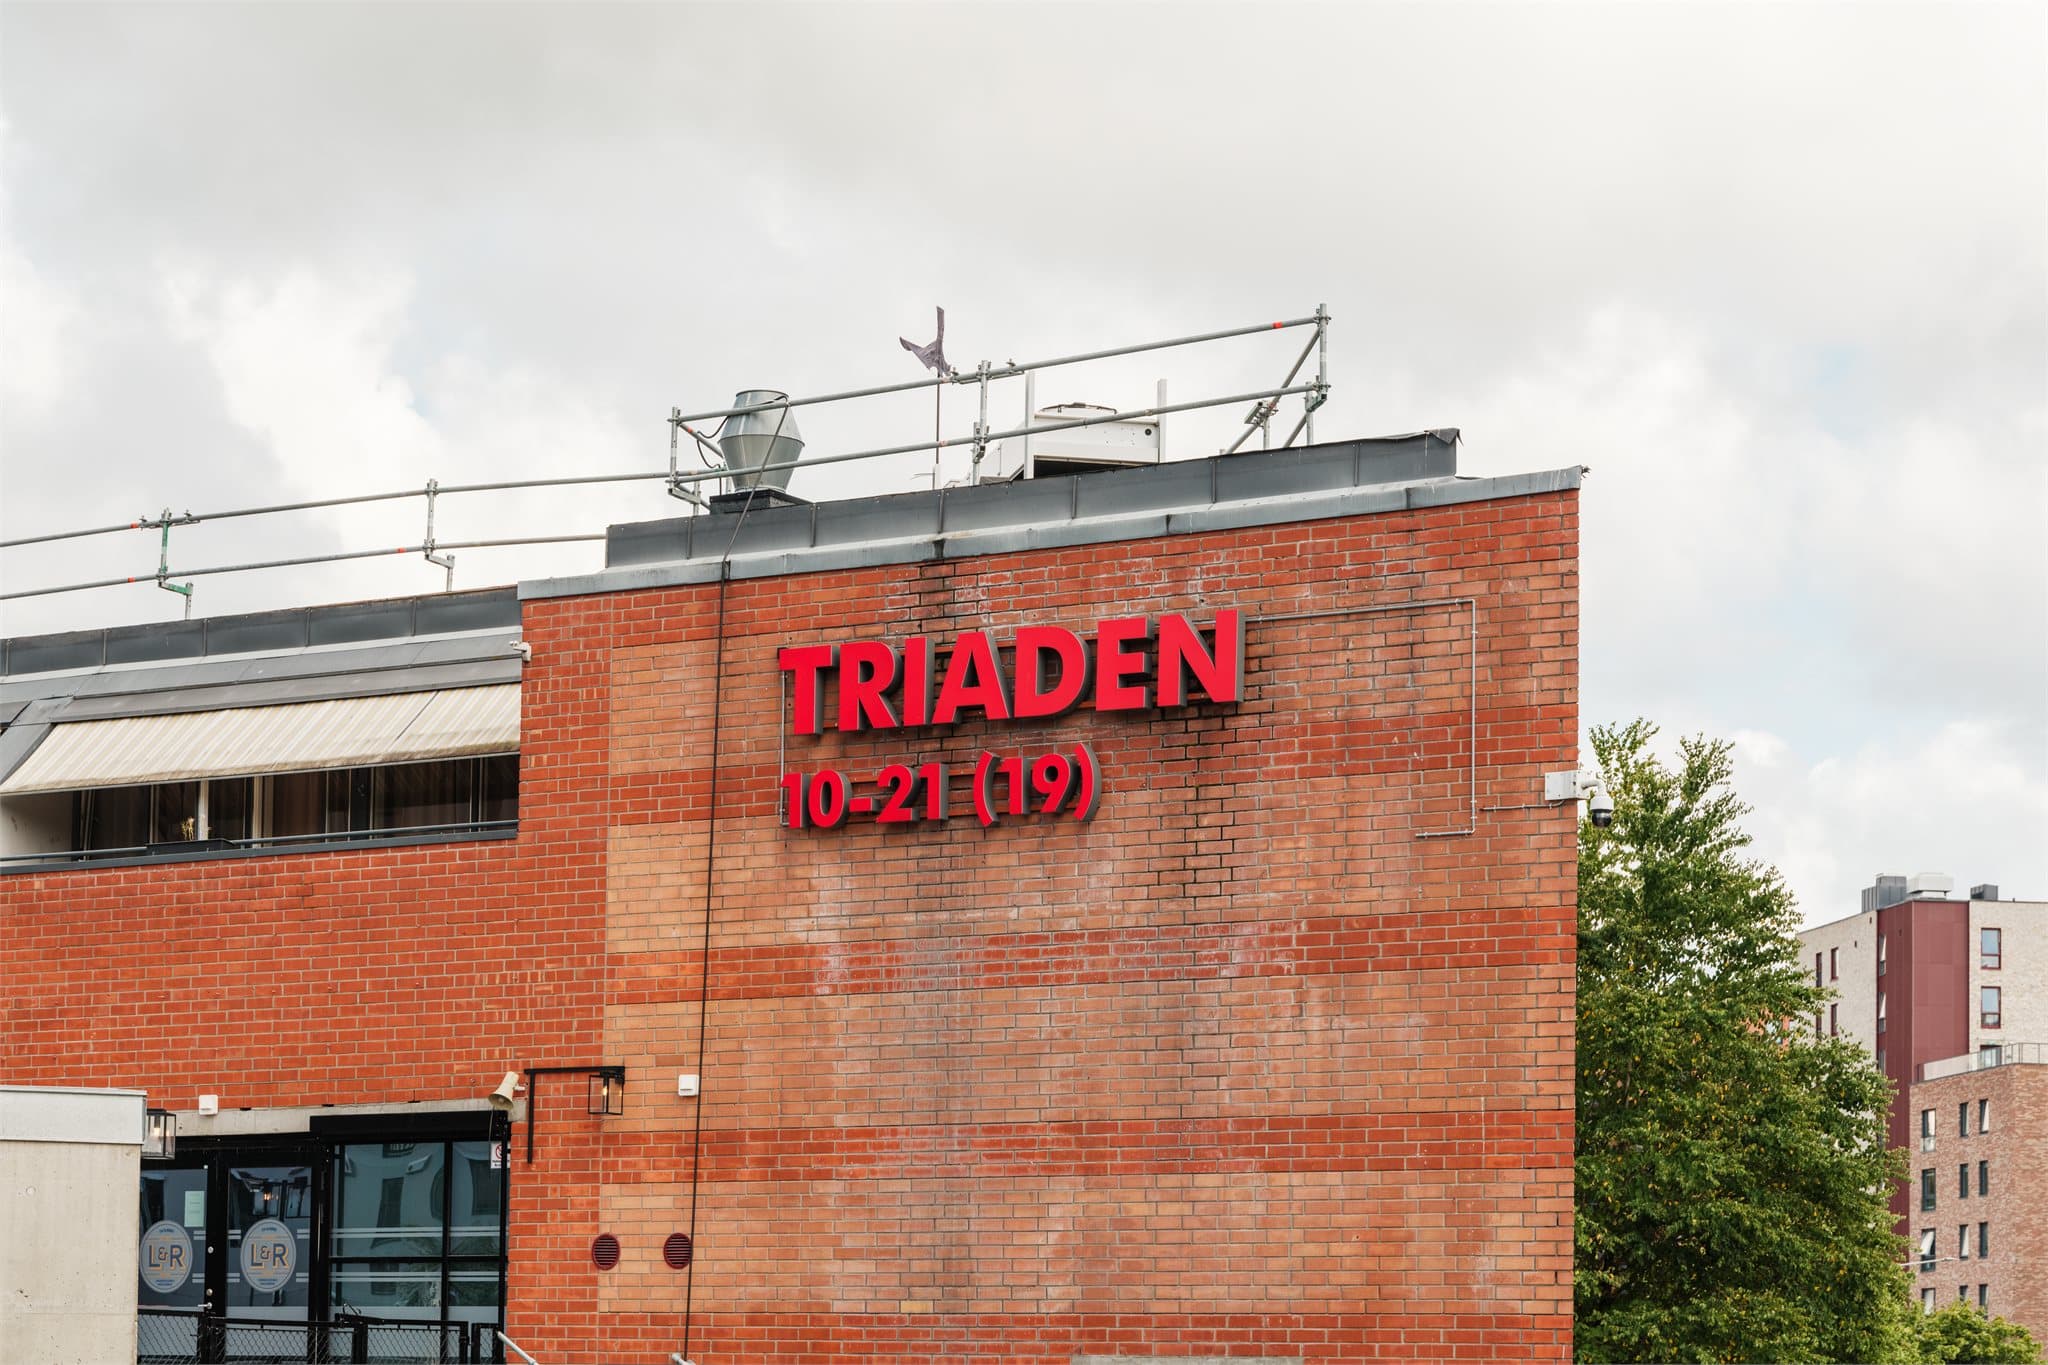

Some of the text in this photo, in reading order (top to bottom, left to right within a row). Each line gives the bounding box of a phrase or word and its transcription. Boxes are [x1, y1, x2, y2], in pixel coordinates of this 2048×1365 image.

[779, 609, 1244, 735] TRIADEN
[781, 742, 1099, 828] 10-21 (19)
[148, 1244, 186, 1270] L&R
[250, 1243, 288, 1268] L&R
